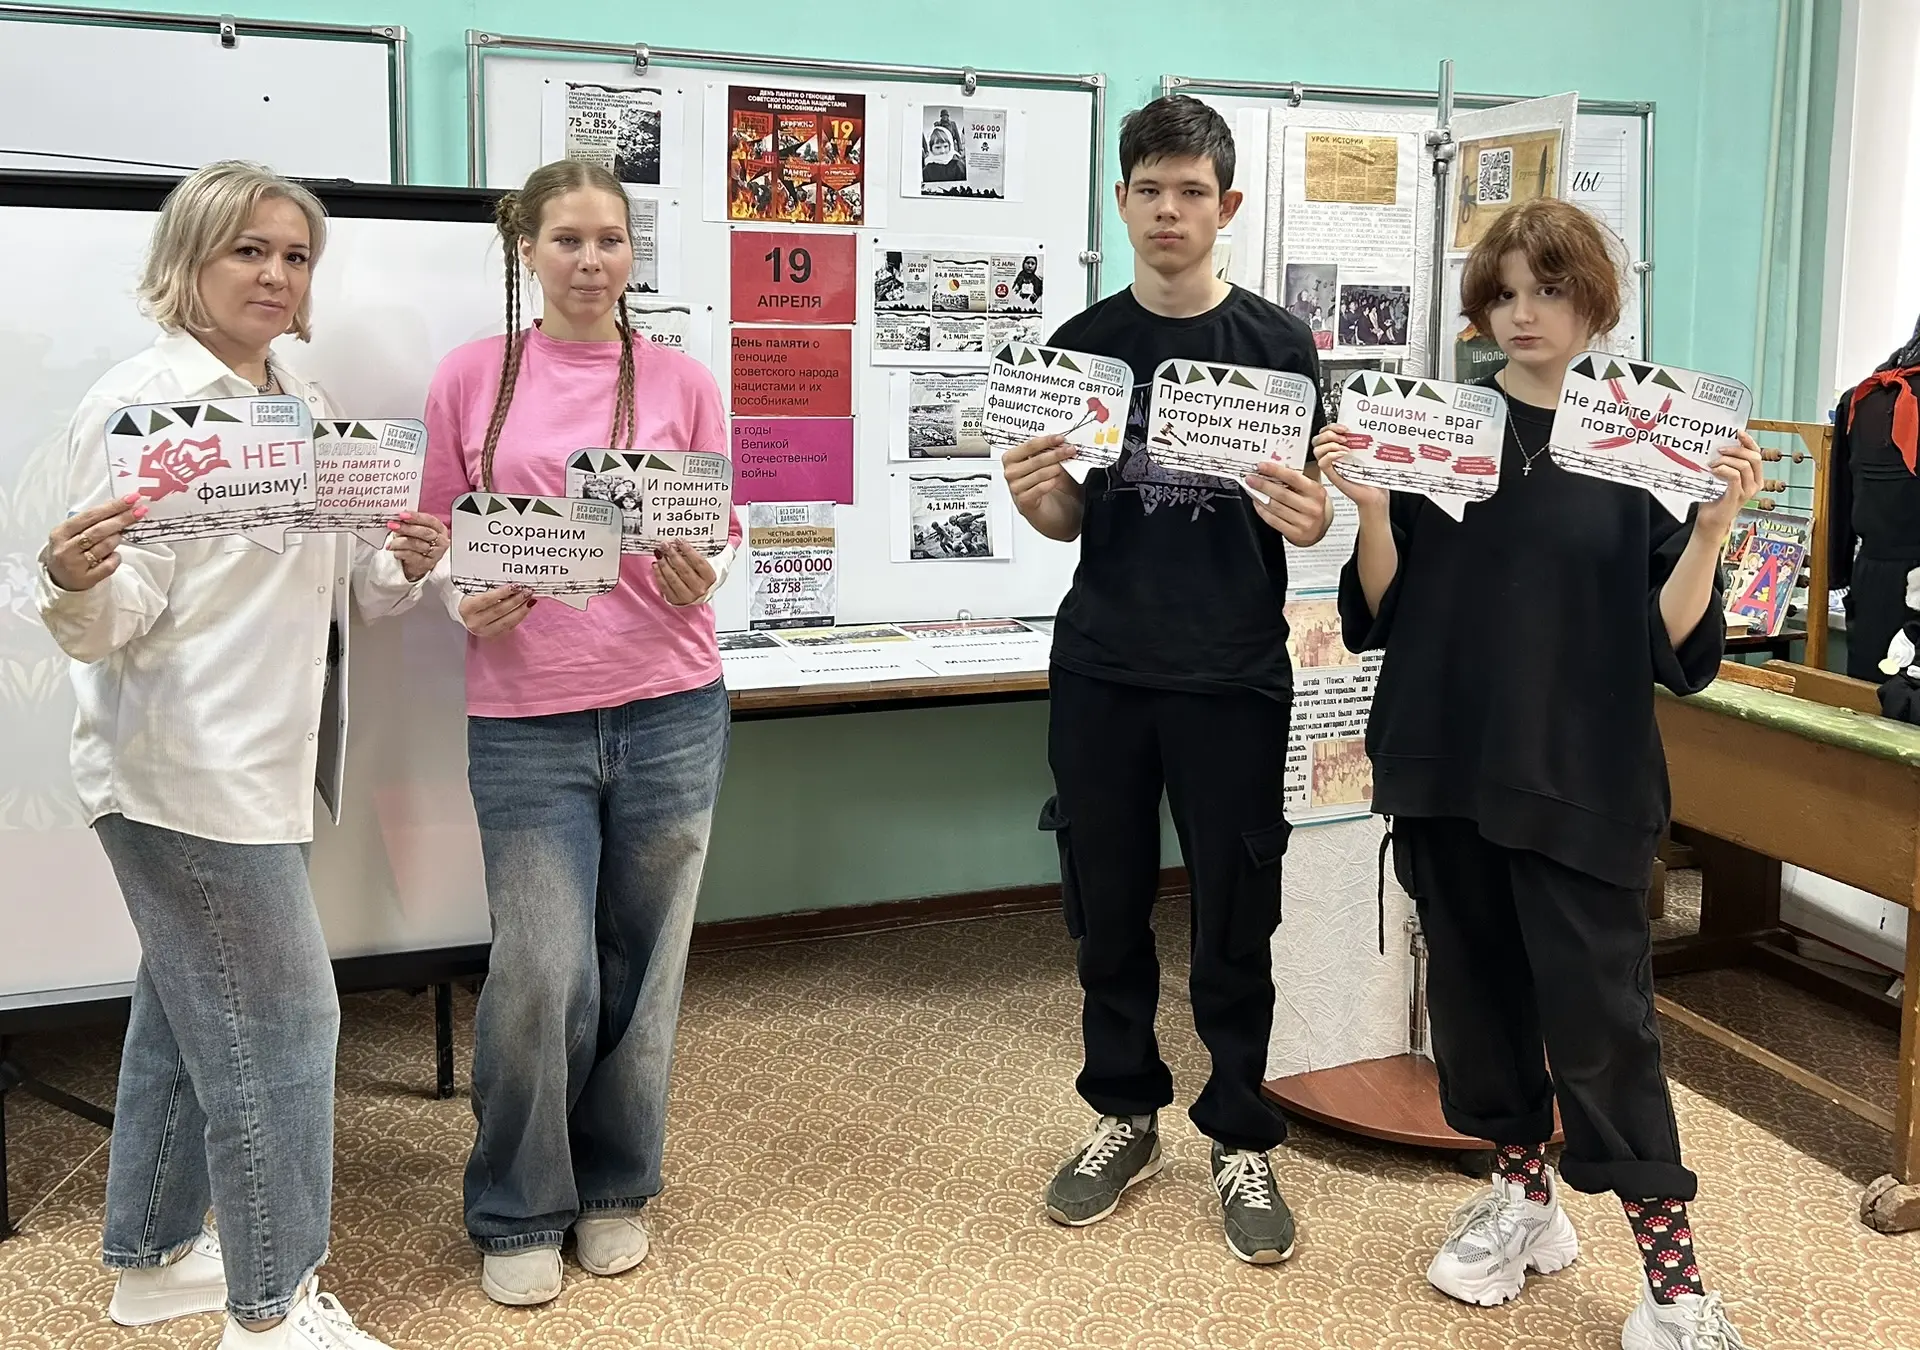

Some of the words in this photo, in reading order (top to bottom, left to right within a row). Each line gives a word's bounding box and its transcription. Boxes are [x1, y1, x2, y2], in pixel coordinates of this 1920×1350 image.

[569, 117, 582, 126] 75
[593, 119, 617, 129] 85%
[831, 120, 853, 139] 19
[971, 124, 985, 132] 306
[1333, 136, 1364, 144] ИСТОРИИ
[765, 247, 811, 283] 19
[757, 295, 821, 308] АПРЕЛЯ
[651, 334, 681, 342] 60-70
[732, 337, 762, 348] День
[734, 353, 787, 362] геноциде
[734, 368, 795, 377] советского
[800, 370, 839, 378] народа
[1094, 363, 1104, 371] БЕЗ
[1105, 365, 1122, 375] СРОКА
[992, 363, 1075, 388] Поклонимся
[1078, 381, 1124, 397] святой
[1092, 370, 1120, 383] ДАВНОСТИ
[734, 382, 795, 392] нацистами
[1272, 379, 1283, 387] БЕЗ
[1283, 381, 1302, 391] СРОКА
[1701, 382, 1714, 392] БЕЗ
[1715, 385, 1737, 398] СРОКА
[990, 381, 1037, 398] памяти
[1040, 390, 1081, 406] жертв
[1270, 386, 1301, 399] ДАВНОСТИ
[1460, 392, 1472, 400] БЕЗ
[1472, 394, 1493, 405] СРОКА
[1698, 390, 1735, 406] ДАВНОСТИ
[734, 395, 809, 405] пособниками
[1159, 384, 1289, 415] Преступления
[1296, 406, 1306, 417] о
[1458, 400, 1491, 413] ДАВНОСТИ
[988, 395, 1073, 420] фашистского
[256, 414, 294, 423] ДАВНОСТИ
[986, 411, 1045, 431] геноцида
[1357, 399, 1427, 422] Фашизм
[1445, 416, 1483, 430] враг
[1563, 389, 1589, 406] Не
[1593, 399, 1650, 421] дайте
[1656, 411, 1738, 440] истории
[1158, 407, 1232, 428] которых
[1238, 419, 1301, 437] нельзя
[399, 431, 417, 441] СРОКА
[745, 427, 771, 436] годы
[1358, 418, 1474, 445] человечества
[1581, 417, 1711, 455] повториться!
[385, 438, 414, 450] ДАВНОСТИ
[741, 439, 789, 449] Великой
[1186, 431, 1267, 453] молчать!
[242, 440, 306, 469] НЕТ
[741, 453, 827, 464] Отечественной
[342, 459, 390, 469] памяти
[394, 459, 401, 467] о
[688, 465, 719, 475] ДАВНОСТИ
[699, 460, 720, 468] СРОКА
[349, 471, 417, 481] советского
[741, 468, 776, 478] войны
[197, 472, 308, 504] фашизму!
[338, 485, 410, 496] нацистами
[647, 479, 658, 490] И
[664, 482, 729, 491] помнить
[652, 496, 722, 509] страшно,
[927, 502, 941, 511] 4,1
[1136, 483, 1216, 523] BERSERK
[575, 512, 608, 521] ДАВНОСТИ
[588, 506, 608, 515] СРОКА
[653, 513, 662, 521] и
[667, 510, 720, 521] забыть
[487, 521, 586, 541] Сохраним
[657, 523, 714, 537] нельзя!
[468, 541, 604, 561] историческую
[1751, 540, 1800, 560] БУКВАРЬ
[502, 562, 569, 575] память
[754, 561, 772, 574] 26
[774, 559, 802, 573] 600
[805, 558, 832, 572] 000
[1317, 711, 1335, 719] школа
